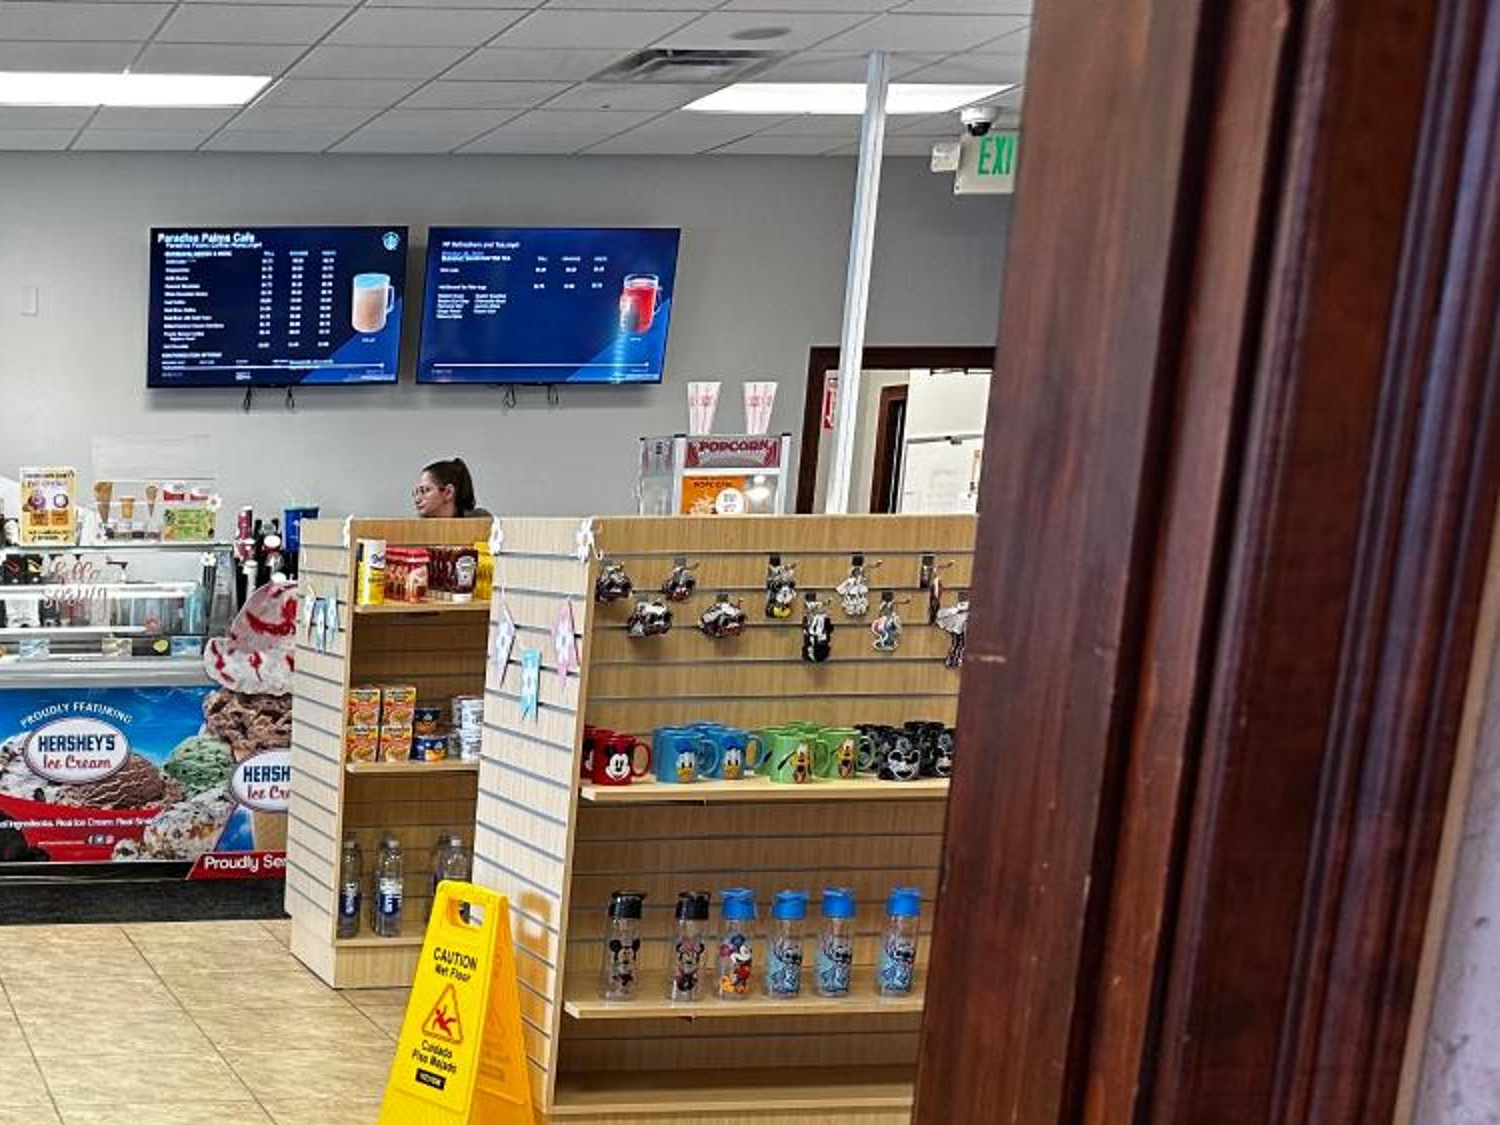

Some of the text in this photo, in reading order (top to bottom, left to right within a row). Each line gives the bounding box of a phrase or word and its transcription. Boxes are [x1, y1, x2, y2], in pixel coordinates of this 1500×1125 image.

[698, 439, 770, 452] POPCORN
[20, 702, 133, 728] PROUDLY FEATURING
[38, 734, 116, 753] HERSHEY'S
[43, 754, 112, 769] Ice Cream
[247, 784, 266, 800] Ice
[204, 855, 259, 873] Proudly
[433, 947, 477, 971] CAUTION
[435, 964, 471, 982] Wet Floor
[421, 1039, 452, 1059] Cuidado
[411, 1048, 456, 1074] Piso Mojado
